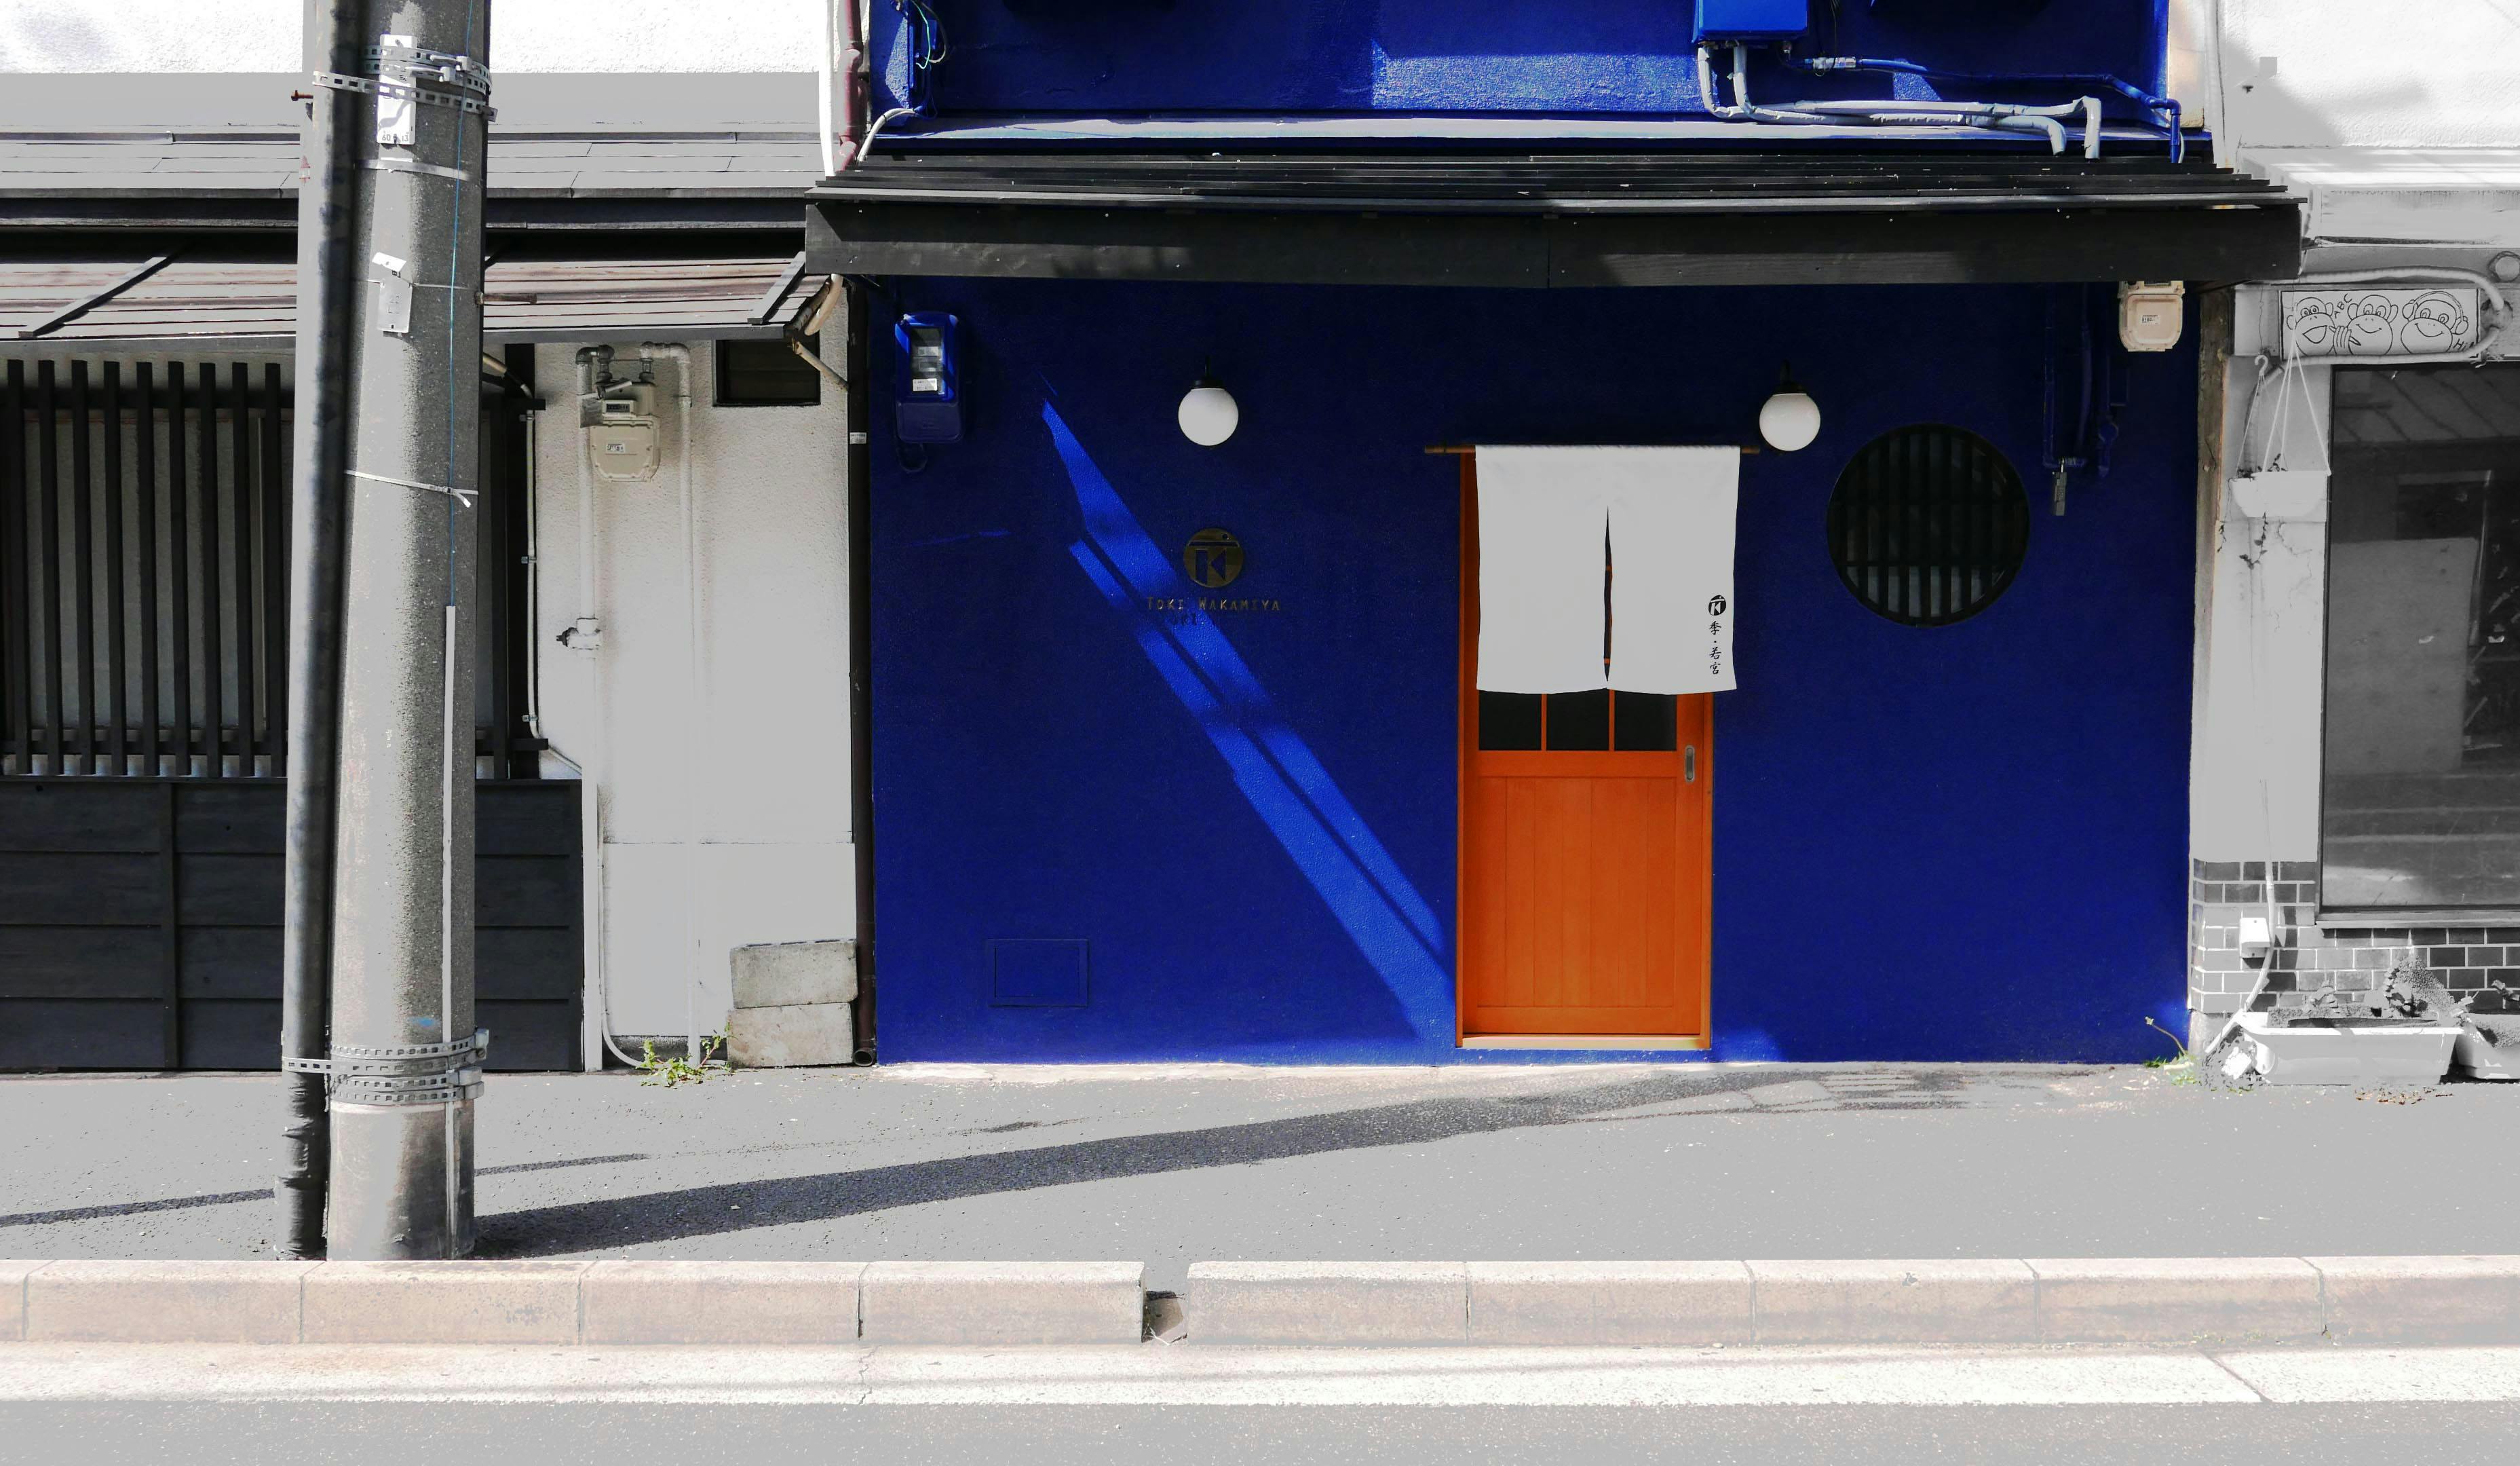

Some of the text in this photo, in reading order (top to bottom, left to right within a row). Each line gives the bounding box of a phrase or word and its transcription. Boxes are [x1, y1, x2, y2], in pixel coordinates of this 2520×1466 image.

[2334, 293, 2352, 319] ABC
[1147, 597, 1280, 611] TOKI WAKAMIYA
